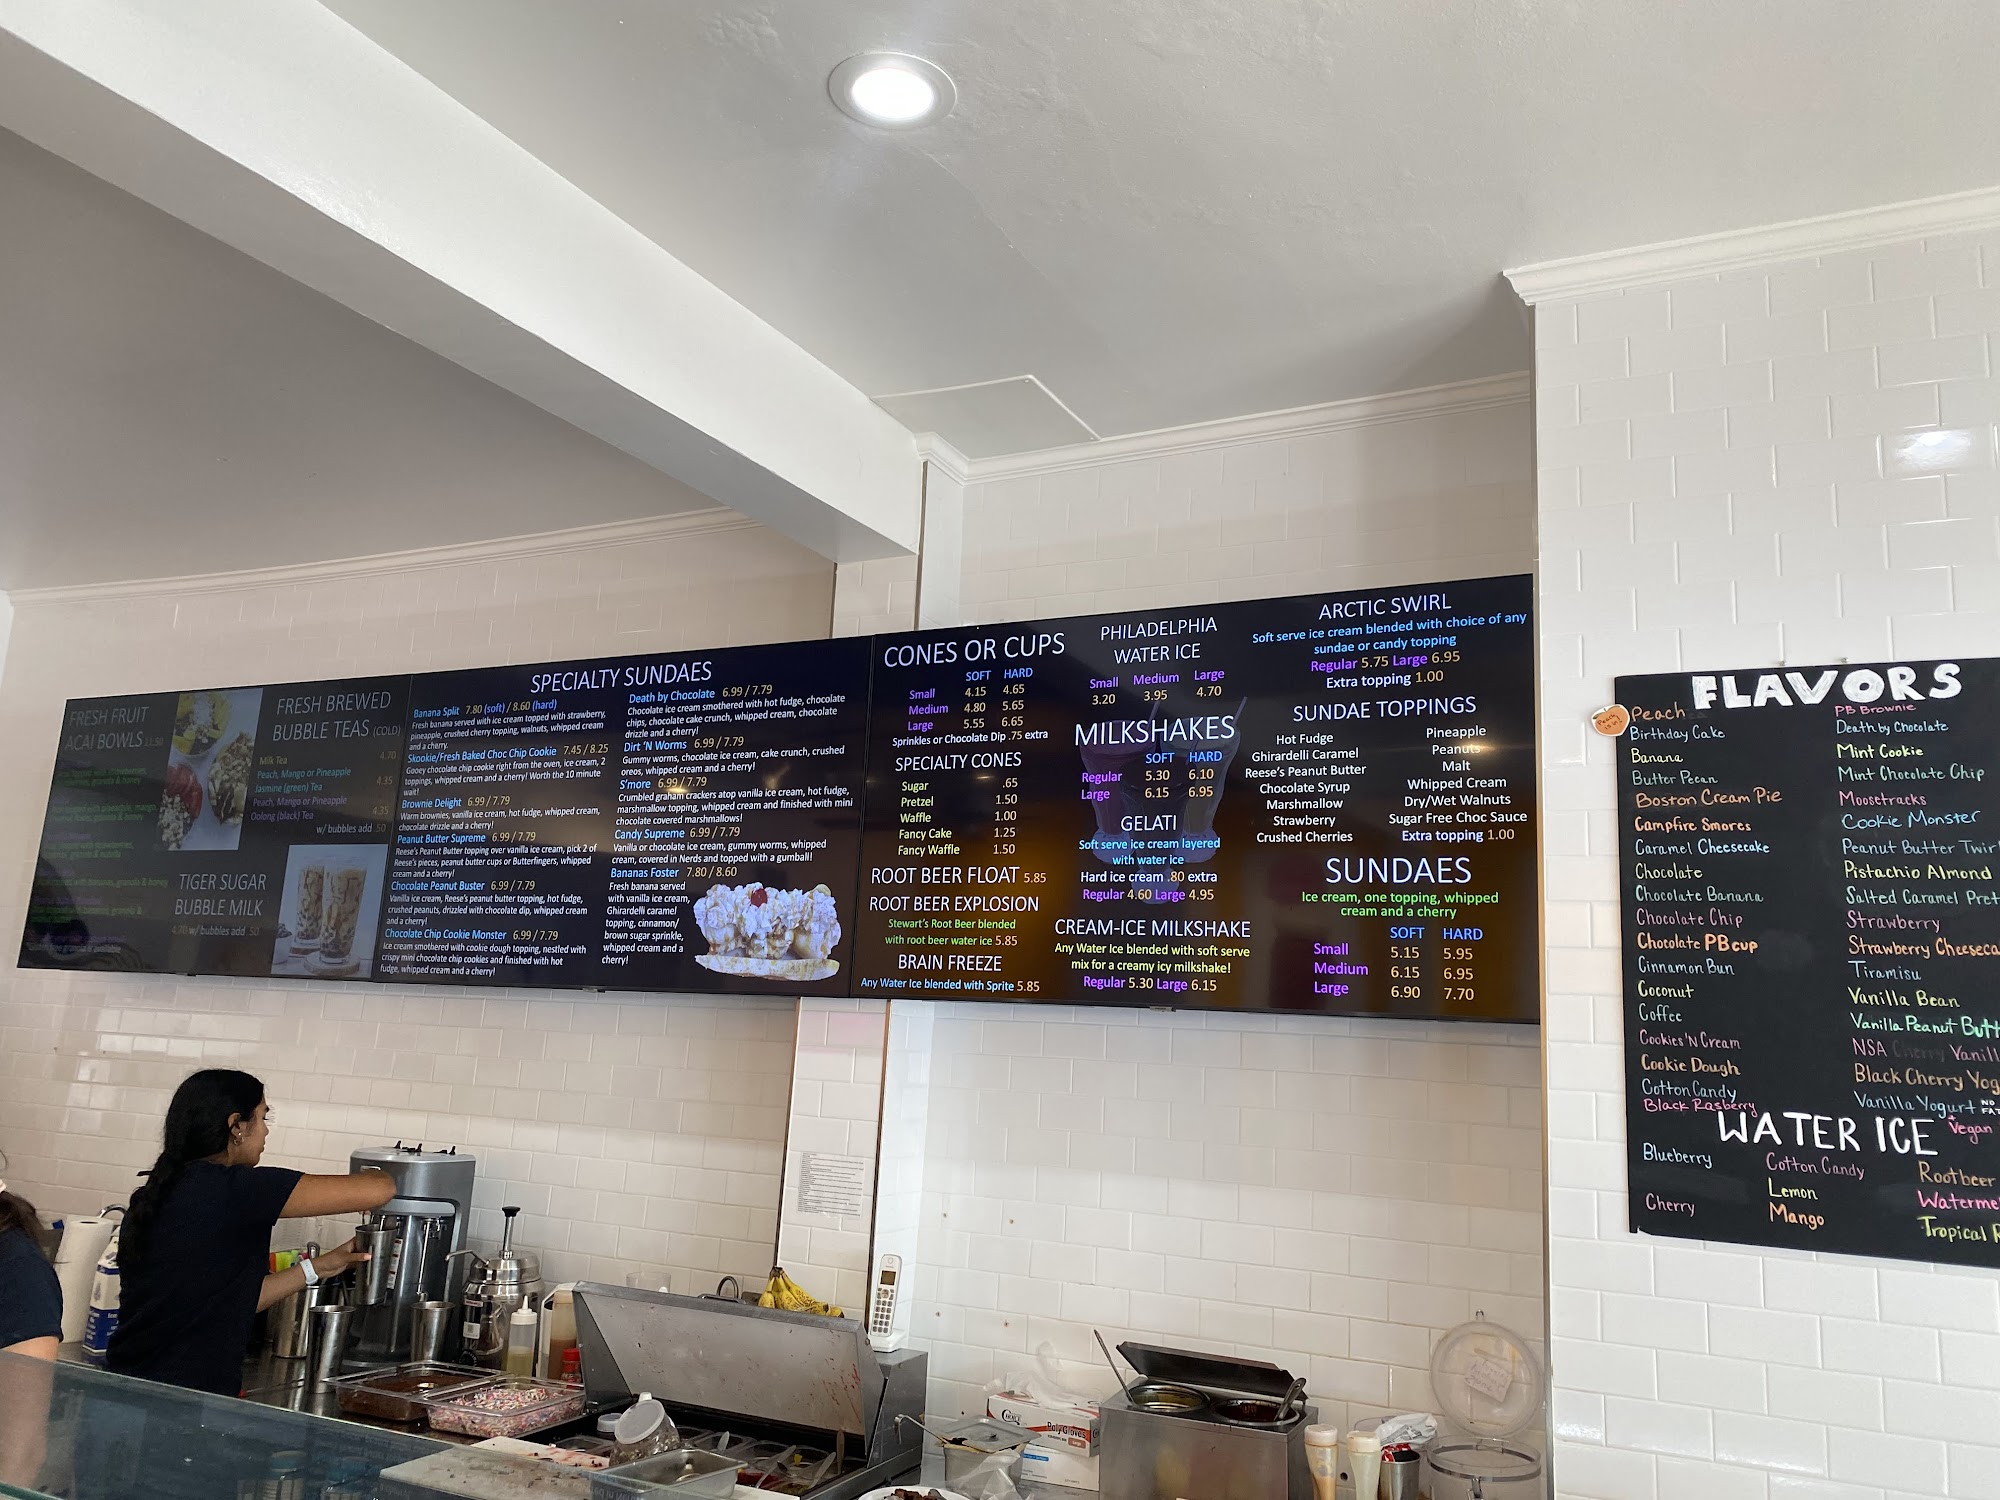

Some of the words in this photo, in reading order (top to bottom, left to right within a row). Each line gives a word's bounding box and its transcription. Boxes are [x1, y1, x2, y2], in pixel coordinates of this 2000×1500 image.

[1319, 599, 1385, 620] ARCTIC
[1391, 594, 1451, 613] SWIRL
[1101, 617, 1217, 640] PHILADELPHIA
[885, 642, 957, 667] CONES
[965, 639, 996, 661] OR
[1005, 633, 1064, 657] CUPS
[1114, 646, 1172, 664] WATER
[1176, 643, 1200, 659] ICE
[531, 668, 620, 693] SPECIALTY
[624, 661, 711, 686] SUNDAES
[966, 670, 991, 681] SOFT
[1004, 668, 1033, 678] HARD
[1327, 677, 1357, 688] Extra
[1361, 673, 1411, 688] topping
[1416, 670, 1443, 682] 1.00
[910, 688, 935, 699] Small
[965, 687, 986, 697] 4.15
[1003, 684, 1024, 694] 4.65
[1692, 663, 1961, 711] FLAVORS
[277, 696, 321, 715] FRESH
[326, 692, 390, 712] BREWED
[628, 706, 663, 715] Chocolate
[665, 705, 675, 713] ice
[702, 700, 743, 711] smothered
[745, 699, 762, 708] with
[765, 698, 778, 707] hot
[780, 697, 804, 707] fudge,
[806, 694, 845, 704] chocolate
[629, 692, 655, 703] Death
[658, 692, 668, 703] by
[671, 689, 715, 700] Chocolate
[414, 709, 441, 718] Banana
[443, 706, 460, 717] Split
[909, 704, 948, 714] Medium
[964, 702, 985, 712] 4.80
[1003, 700, 1024, 710] 5.65
[1294, 702, 1370, 721] SUNDAE
[1376, 696, 1476, 717] TOPPINGS
[1632, 702, 1685, 722] Peach
[69, 710, 107, 727] FRESH
[111, 707, 149, 724] FRUIT
[908, 722, 933, 732] Large
[964, 718, 984, 728] 5.55
[1002, 716, 1023, 726] 6.65
[273, 722, 329, 741] BUBBLE
[334, 720, 369, 738] TEAS
[373, 725, 401, 738] (COLD)
[1076, 716, 1234, 745] MILKSHAKES
[1427, 725, 1486, 739] Pineapple
[1630, 726, 1688, 742] Birthday
[1693, 725, 1725, 739] Cake
[1837, 720, 1877, 733] Death
[1878, 723, 1890, 735] by
[1894, 720, 1948, 732] Chocolate
[65, 734, 95, 750] ACAI
[98, 731, 143, 749] BOWLS
[893, 736, 930, 748] Sprinkles
[945, 733, 988, 743] Chocolate
[991, 732, 1006, 742] Dip
[1008, 730, 1022, 741] .75
[1025, 731, 1048, 739] extra
[1277, 735, 1296, 744] Hot
[1300, 733, 1333, 745] Fudge
[408, 752, 460, 763] Skookie/Fresh
[462, 750, 485, 760] Baked
[487, 749, 507, 759] Choc
[509, 748, 527, 759] Chip
[529, 747, 556, 756] Cookie
[1252, 750, 1308, 761] Ghirardelli
[1313, 747, 1358, 759] Caramel
[1432, 744, 1480, 755] Peanuts
[1631, 748, 1683, 763] Banana
[1837, 744, 1874, 758] Mint
[1880, 744, 1923, 758] Cookie
[895, 754, 968, 771] SPECIALTY
[972, 752, 1021, 768] CONES
[1443, 760, 1470, 771] Malt
[1246, 767, 1285, 778] Reese's
[1289, 766, 1327, 776] Peanut
[1331, 765, 1366, 775] Butter
[620, 779, 651, 789] S'more
[902, 782, 929, 793] Sugar
[1003, 778, 1017, 788] .65
[402, 799, 432, 808] Brownie
[435, 798, 462, 809] Delight
[901, 796, 933, 807] Pretzel
[996, 794, 1017, 804] 1.50
[1636, 793, 1697, 808] Boston
[1701, 789, 1750, 805] Cream
[1753, 787, 1782, 804] Pie
[1839, 791, 1926, 806] Moosetracks
[1121, 815, 1176, 831] GELATI
[1635, 816, 1697, 833] Campfire
[1702, 818, 1751, 831] Smores
[1842, 814, 1902, 829] Cookie
[1909, 810, 1980, 828] Monster
[398, 835, 424, 844] Peanut
[425, 834, 449, 843] Butter
[451, 834, 486, 844] Supreme
[615, 829, 642, 841] Candy
[644, 829, 685, 840] Supreme
[1079, 838, 1099, 850] Soft
[1131, 839, 1144, 849] ice
[1182, 838, 1220, 850] layered
[611, 868, 648, 878] Bananas
[651, 868, 679, 877] Foster
[872, 868, 917, 883] ROOT
[922, 867, 961, 883] BEER
[968, 867, 1020, 883] FLOAT
[1024, 873, 1046, 883] 5.85
[1326, 857, 1471, 883] SUNDAES
[1845, 860, 1920, 878] Pistachio
[1928, 865, 1992, 879] Almond
[180, 874, 216, 890] TIGER
[220, 874, 266, 890] SUGAR
[175, 899, 226, 915] BUBBLE
[229, 900, 263, 916] MILK
[1055, 919, 1146, 935] CREAM-ICE
[1152, 920, 1250, 937] MILKSHAKE
[1847, 910, 1939, 933] Strawberry
[1391, 927, 1424, 938] SOFT
[1444, 928, 1482, 940] HARD
[1314, 943, 1348, 955] Small
[1391, 947, 1419, 958] 5.15
[1444, 948, 1472, 960] 5.95
[899, 955, 942, 970] BRAIN
[949, 955, 1002, 971] FREEZE
[1848, 961, 1921, 980] Tiramisu
[1638, 980, 1694, 998] Coconut
[1848, 987, 1910, 1006] Vanilla
[1916, 990, 1960, 1007] Bean
[1853, 1038, 1887, 1056] NSA
[1642, 1054, 1687, 1071] Cookie
[1691, 1057, 1741, 1077] Dough
[1718, 1111, 1860, 1151] WATER
[1876, 1117, 1938, 1155] ICE
[1644, 1143, 1712, 1169] Blueberry
[1769, 1178, 1818, 1199] Lemon
[1646, 1193, 1694, 1217] Cherry
[1770, 1202, 1824, 1230] Mango
